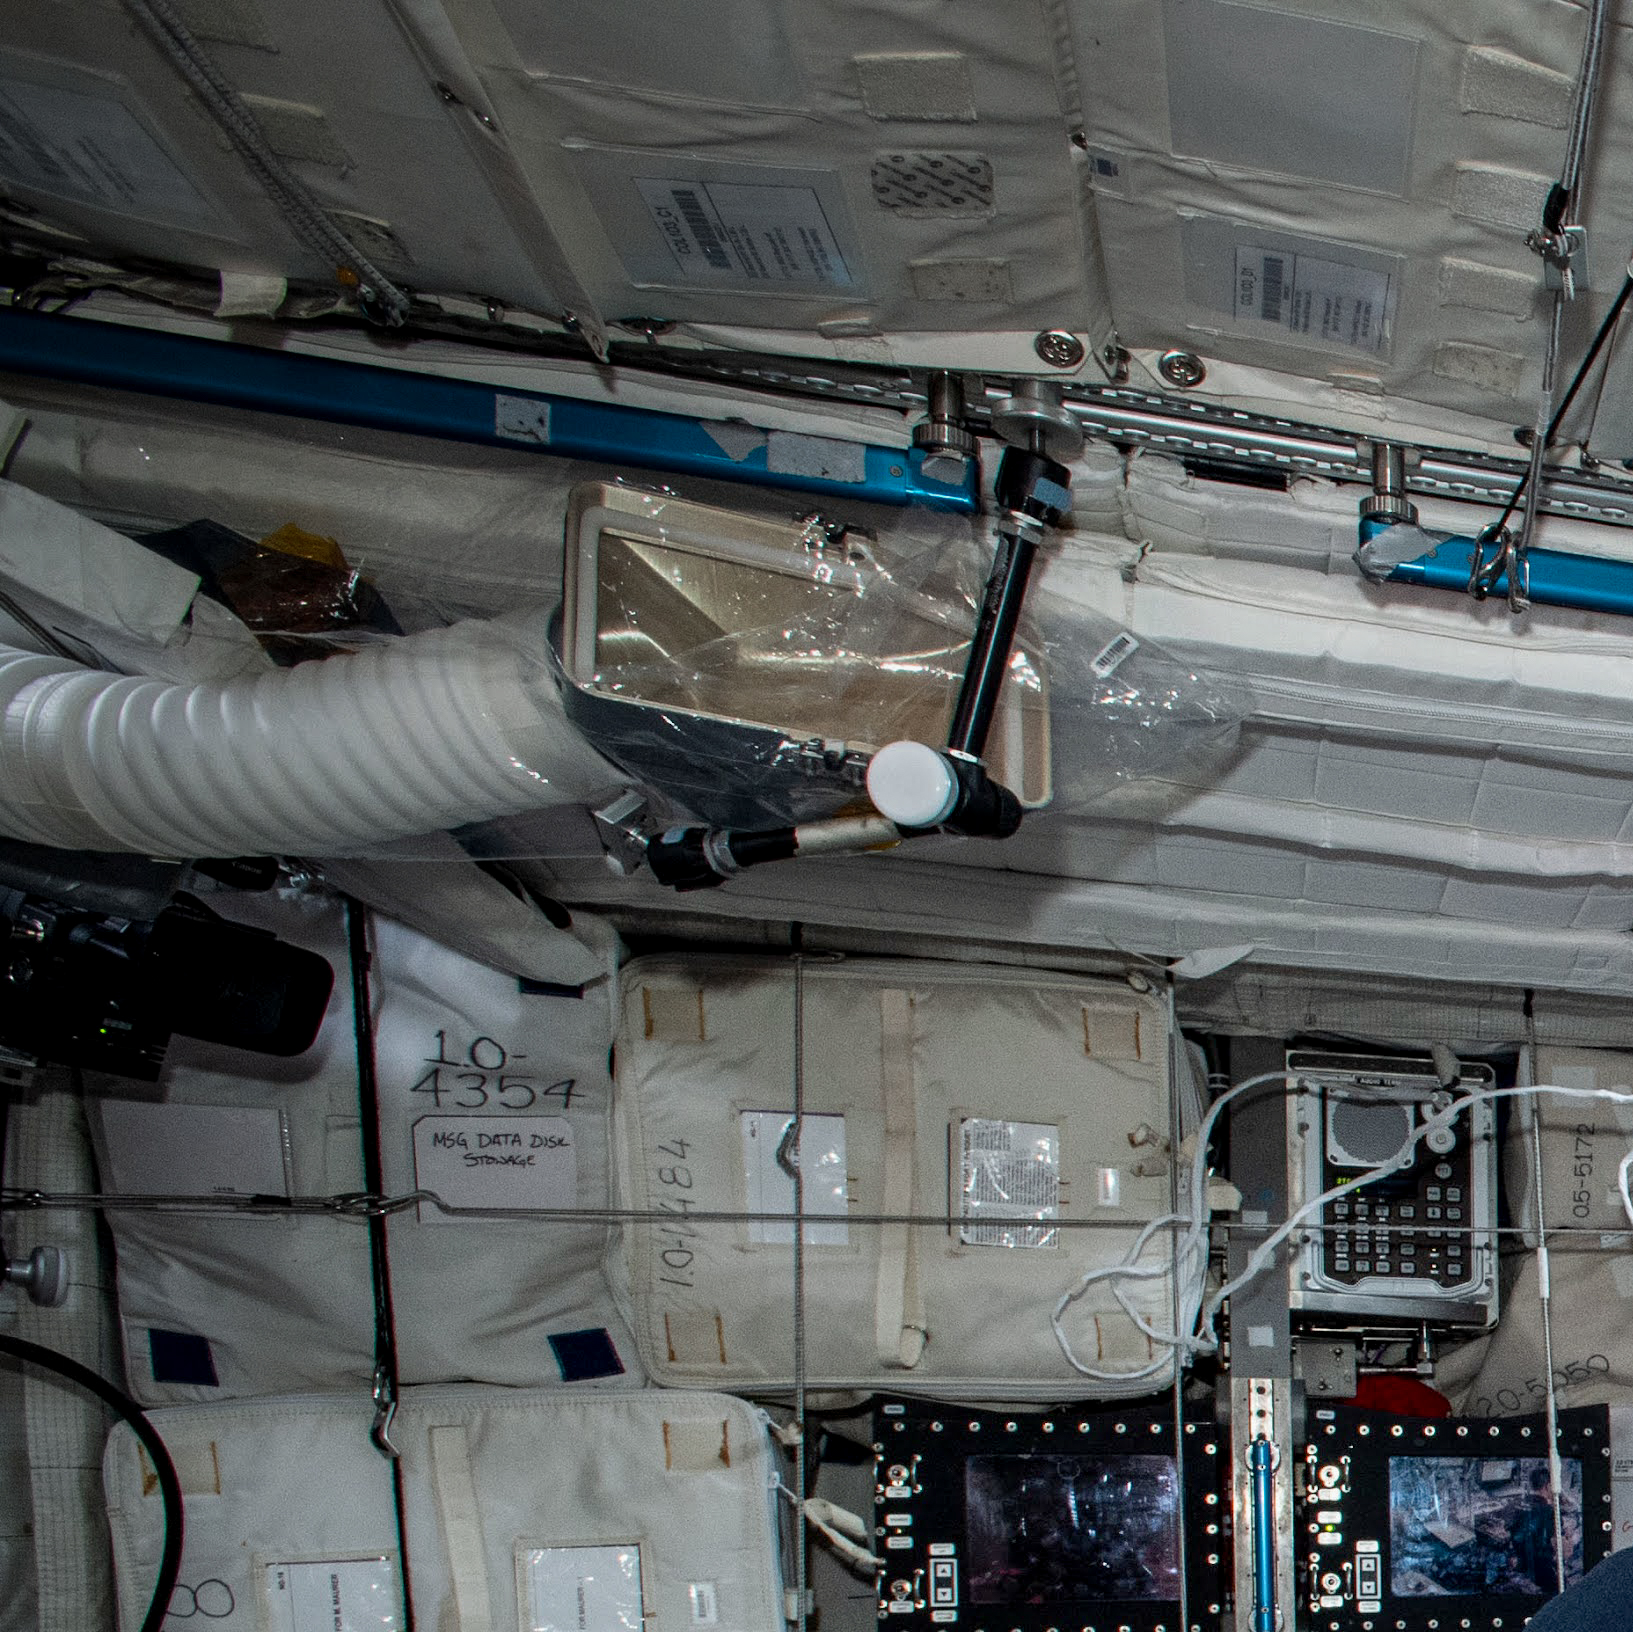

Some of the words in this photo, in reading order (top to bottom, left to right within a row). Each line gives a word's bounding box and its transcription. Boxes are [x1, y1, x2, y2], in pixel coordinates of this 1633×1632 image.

[409, 1071, 588, 1111] 4354
[432, 1131, 471, 1148] MSG
[476, 1131, 522, 1147] DATA
[529, 1131, 572, 1149] DISK
[460, 1152, 537, 1169] STOWAGE
[331, 1574, 341, 1605] MAURER
[334, 1616, 343, 1632] FOR
